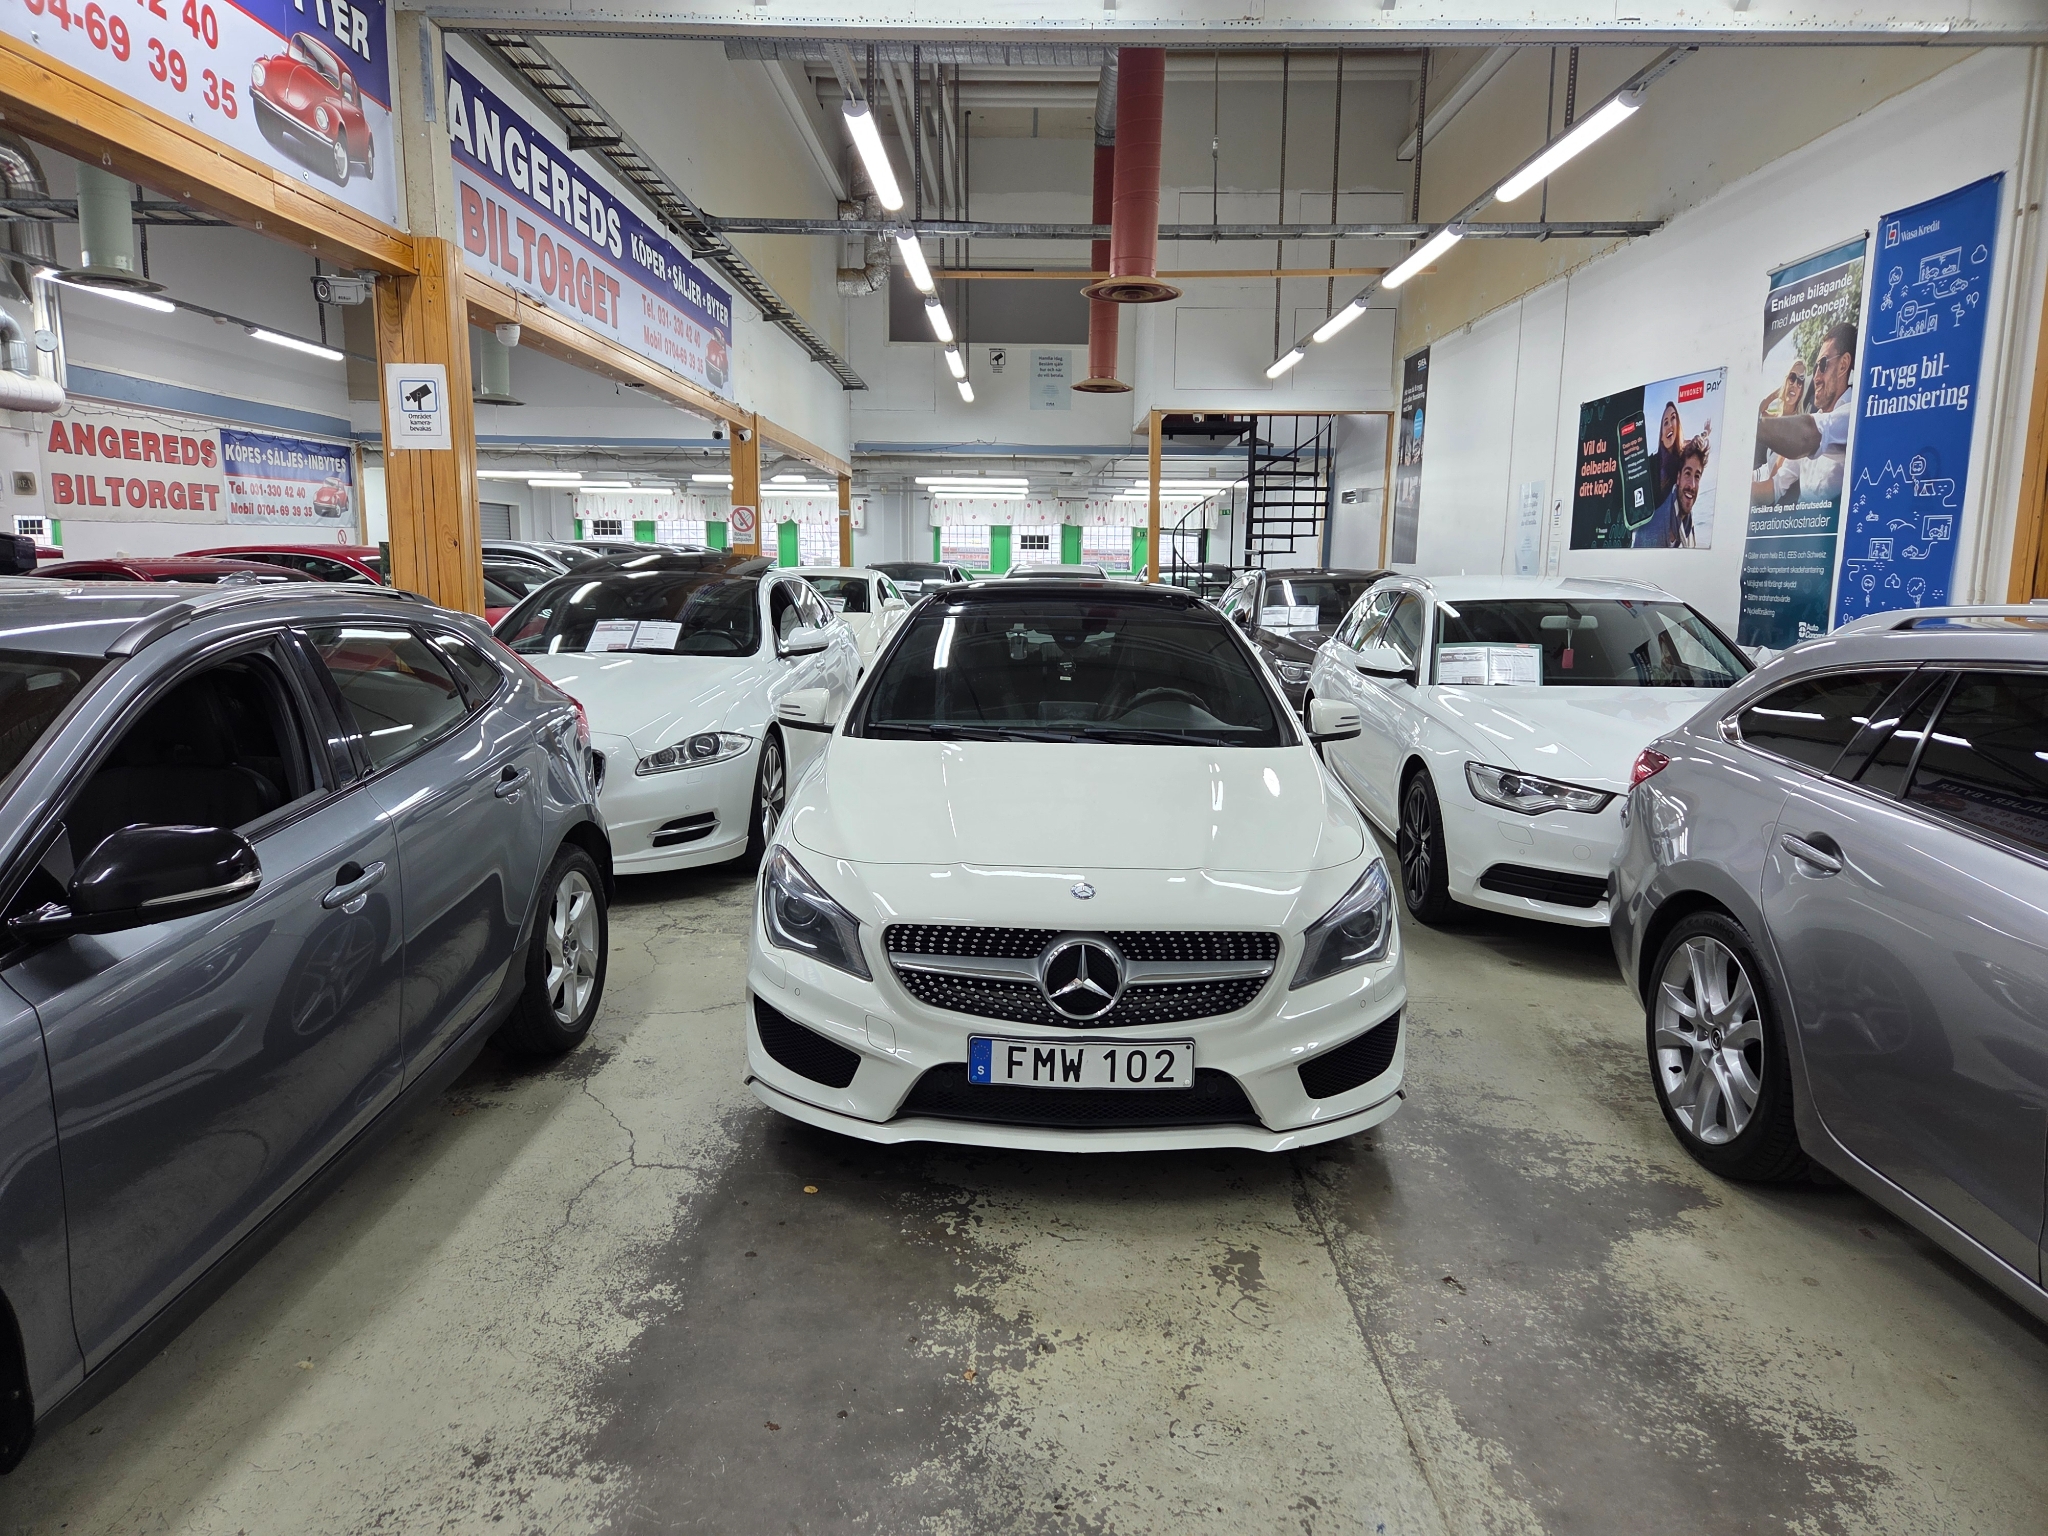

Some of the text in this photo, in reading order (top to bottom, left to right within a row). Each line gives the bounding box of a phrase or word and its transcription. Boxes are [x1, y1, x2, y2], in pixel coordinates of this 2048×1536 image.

[148, 37, 188, 93] 39
[202, 68, 238, 120] 35
[450, 78, 729, 328] ANGEREDS KÖPER SÄLJER BYTER
[1901, 219, 1940, 242] Wasa Kredit
[460, 180, 620, 329] BILTORGET
[1771, 272, 1853, 313] Enklare bilägande
[642, 293, 656, 321] Tel.
[686, 322, 693, 344] 42
[694, 327, 701, 349] 40
[1771, 293, 1850, 331] med AutoConcept
[643, 324, 662, 350] Mobil
[689, 350, 696, 369] 39
[697, 356, 704, 375] 35
[1706, 380, 1722, 393] PAY
[1870, 352, 1950, 392] Trygg bil-
[1864, 382, 1971, 418] finansiering
[47, 420, 218, 468] ANGEREDS
[224, 441, 347, 473] KÖPES SÄLJES INBYTES
[1583, 438, 1607, 456] Vill du
[1581, 457, 1617, 477] delbetala
[51, 473, 220, 511] BILTORGET
[228, 481, 306, 499] Tel. 031-330 42 40
[1579, 478, 1614, 498] ditt köp?
[230, 502, 313, 517] Mobil 0704-69 39 35
[1748, 514, 1831, 533] reparationskostnader
[1750, 500, 1832, 514] Försäkra dig mot oförutsedda
[977, 1045, 1176, 1084] S FMW 102
